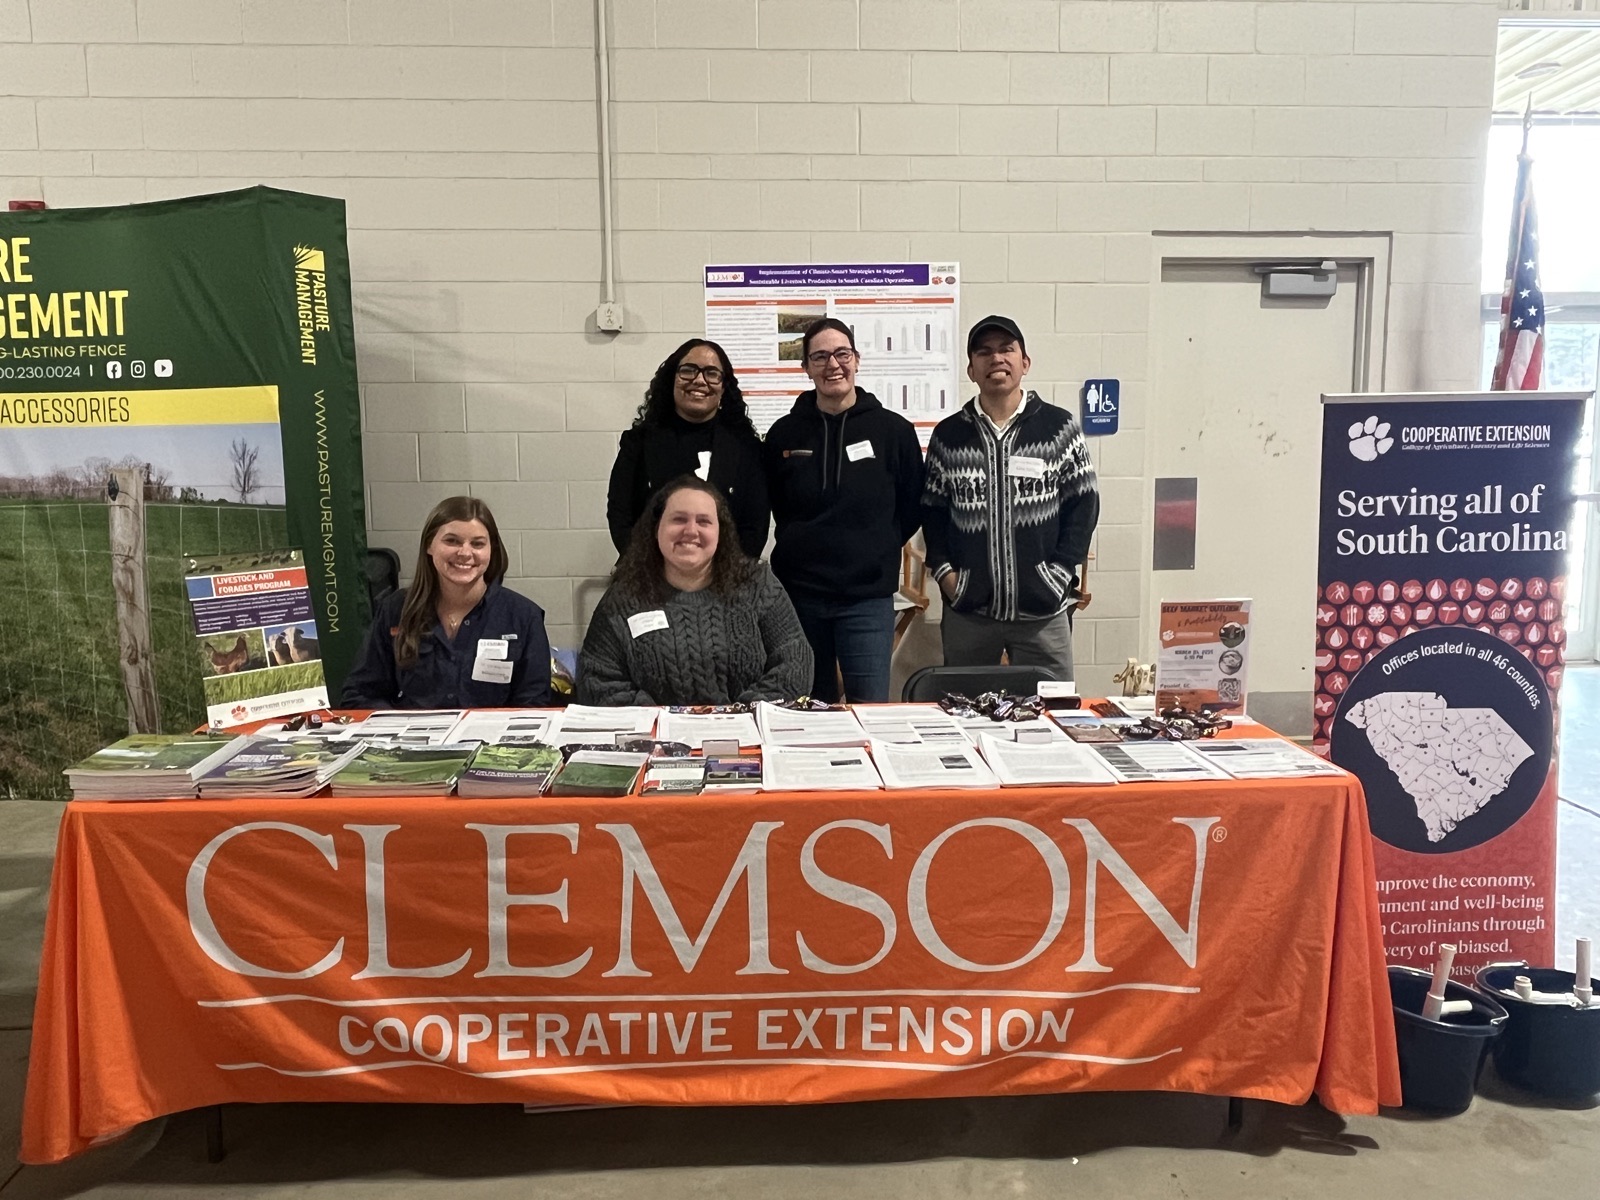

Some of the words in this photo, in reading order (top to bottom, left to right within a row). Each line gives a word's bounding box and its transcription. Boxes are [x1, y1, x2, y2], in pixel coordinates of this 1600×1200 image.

[0, 290, 129, 339] EMENT
[312, 271, 330, 332] PASTURE
[295, 270, 316, 366] MANAGEMENT
[80, 344, 127, 357] FENCE
[0, 397, 130, 424] ACCESSORIES
[1401, 425, 1483, 443] COOPERATIVE
[1485, 424, 1550, 442] EXTENSION
[313, 389, 340, 633] WWW.PASTUREMGMT.COM
[1337, 487, 1458, 522] Serving
[1464, 485, 1502, 514] all
[1510, 484, 1545, 514] of
[1336, 524, 1429, 555] South
[1436, 523, 1567, 554] Carolina
[216, 574, 258, 584] LIVESTOCK
[258, 572, 274, 581] AND
[218, 584, 253, 594] FORAGES
[254, 580, 291, 591] PROGRAM
[1382, 651, 1419, 676] Offices
[1420, 642, 1463, 658] located
[1465, 643, 1476, 657] in
[1478, 649, 1493, 663] all
[1492, 654, 1507, 670] 46
[1506, 666, 1541, 710] counties.
[1432, 874, 1457, 889] the
[1460, 874, 1536, 891] economy,
[186, 816, 1221, 979] CLEMSON
[1430, 896, 1459, 912] and
[1464, 894, 1544, 911] well-being
[1390, 918, 1479, 936] Carolinians
[1483, 916, 1545, 934] through
[1419, 941, 1437, 956] of
[1438, 938, 1513, 954] biased,
[338, 1011, 733, 1064] COOPERATIVE
[757, 1006, 1074, 1057] EXTENSION
